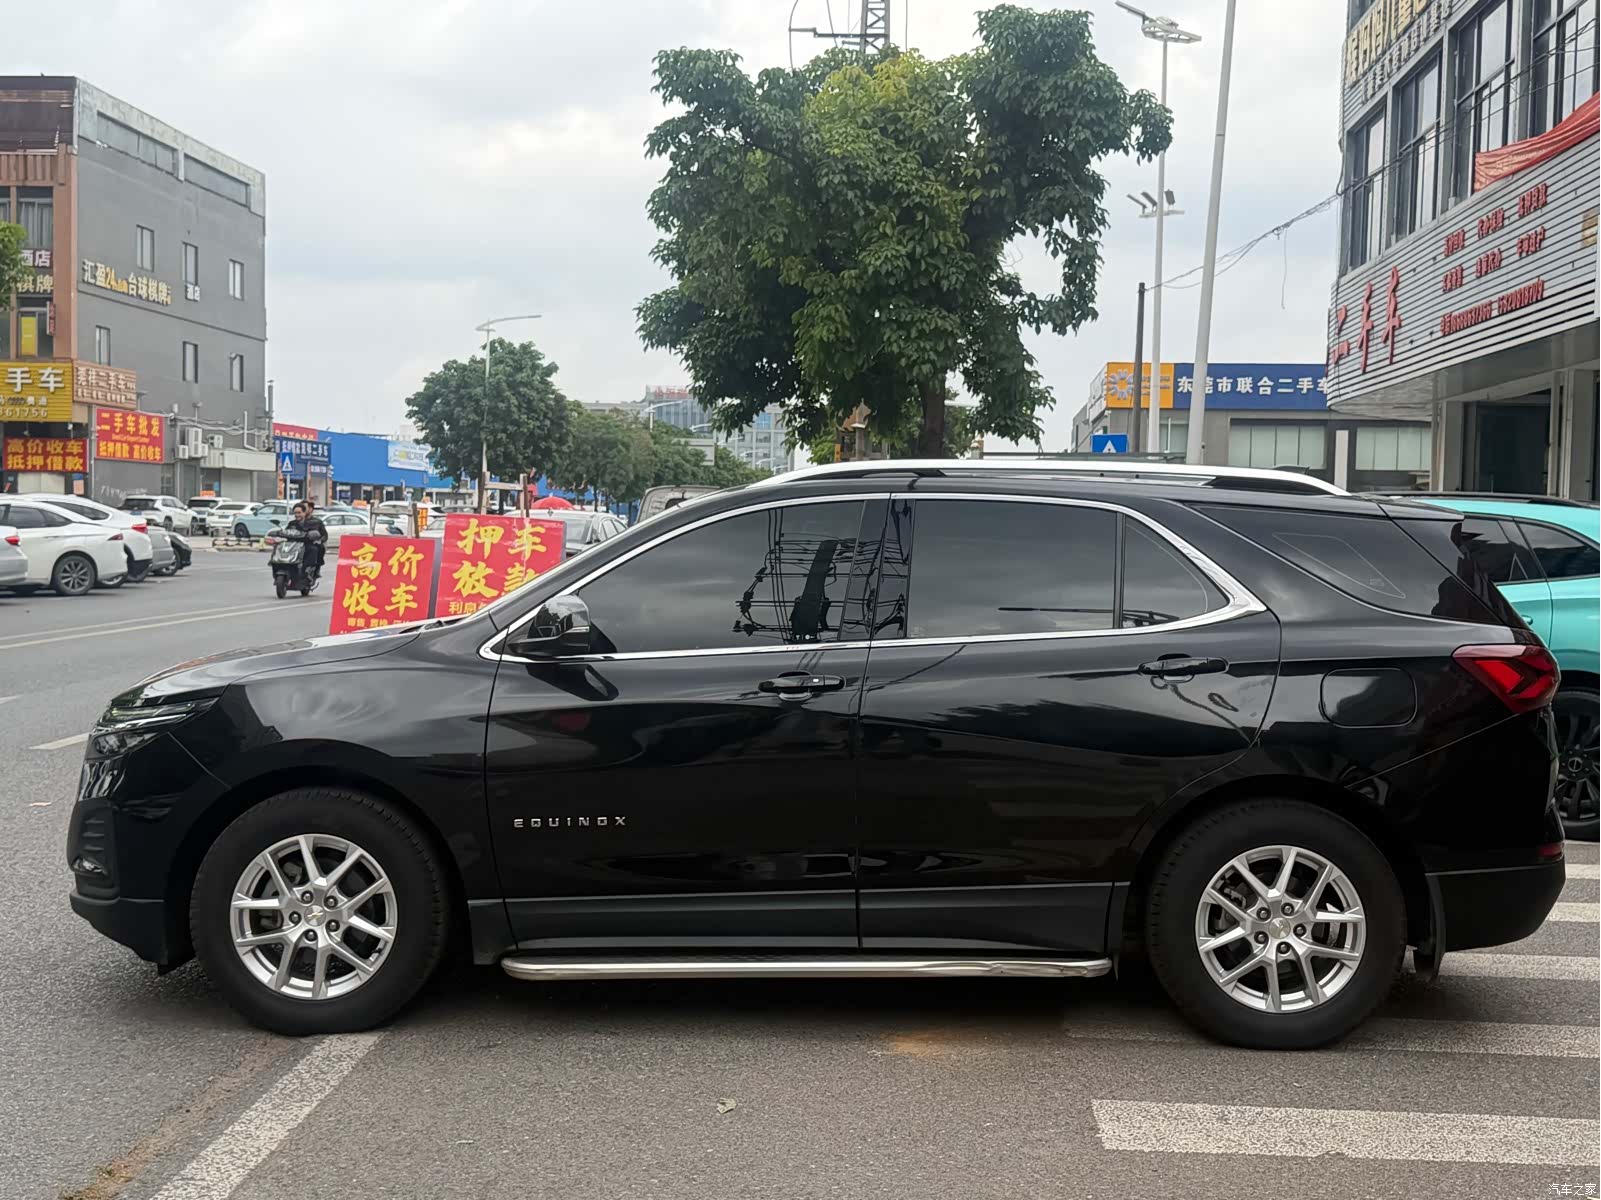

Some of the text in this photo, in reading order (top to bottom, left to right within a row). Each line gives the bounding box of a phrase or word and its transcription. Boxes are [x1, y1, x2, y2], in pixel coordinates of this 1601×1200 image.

[5, 367, 65, 393] 手车
[101, 412, 160, 436] 二手车批发
[7, 439, 83, 454] 高价收车
[7, 454, 83, 470] 抵押借款
[457, 518, 547, 561] 押车
[351, 542, 425, 581] 高价
[342, 580, 419, 617] 收车
[513, 816, 627, 828] EQUINOX
